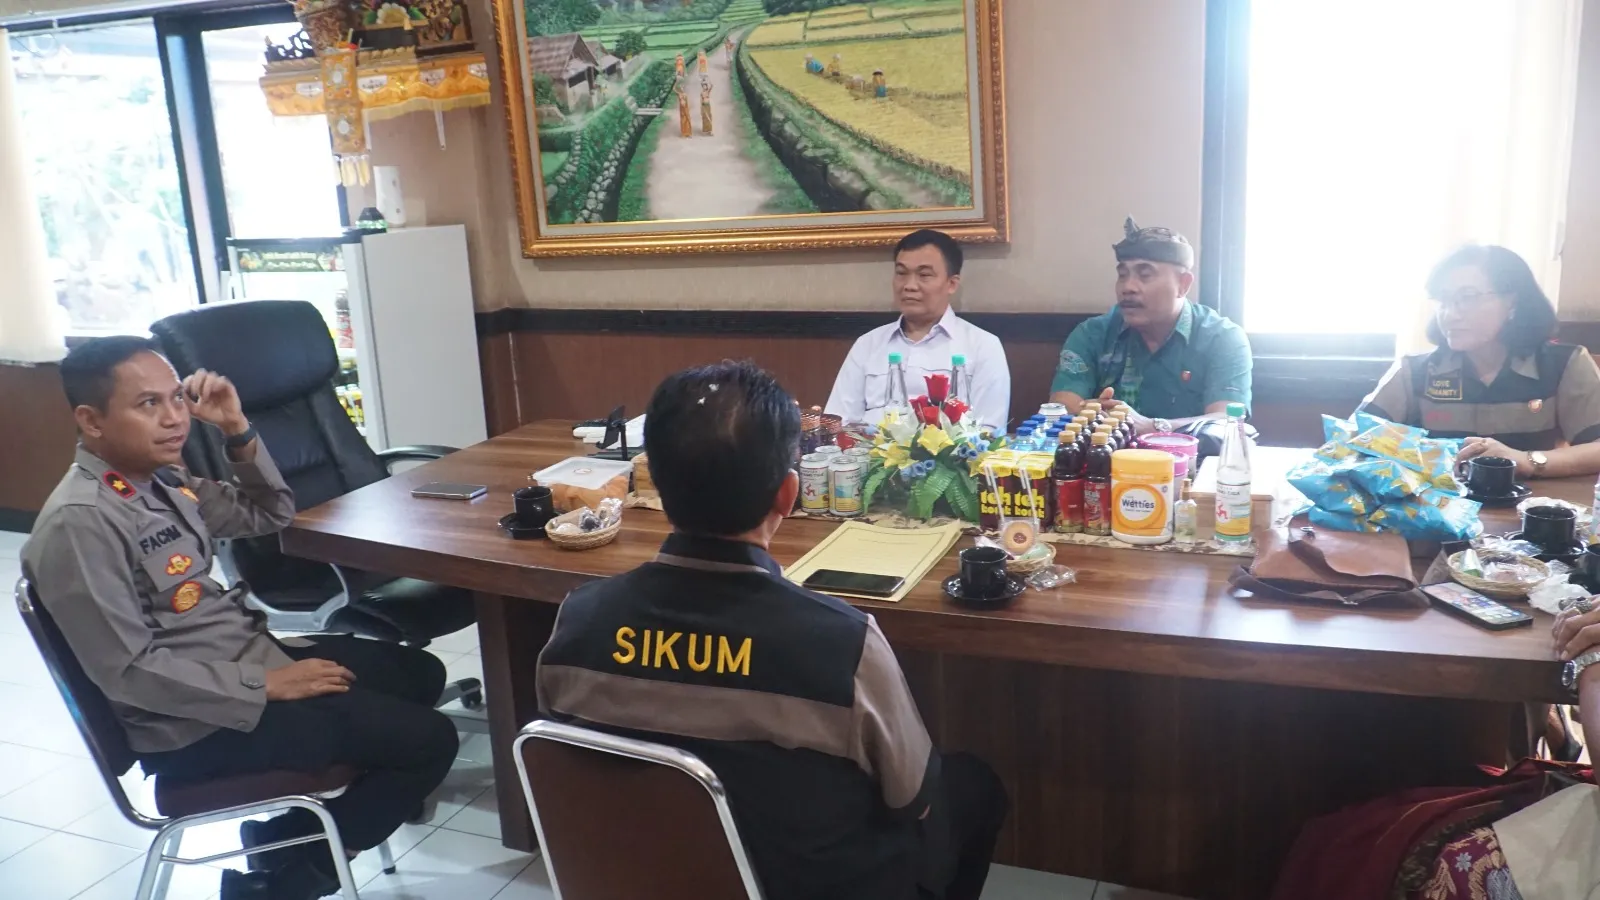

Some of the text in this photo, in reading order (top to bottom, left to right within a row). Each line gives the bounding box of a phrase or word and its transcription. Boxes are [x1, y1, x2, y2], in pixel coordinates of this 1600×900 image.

[981, 486, 1011, 506] teh
[1015, 489, 1045, 509] teh
[1121, 498, 1155, 509] Wetties
[612, 626, 752, 676] SIKUM
